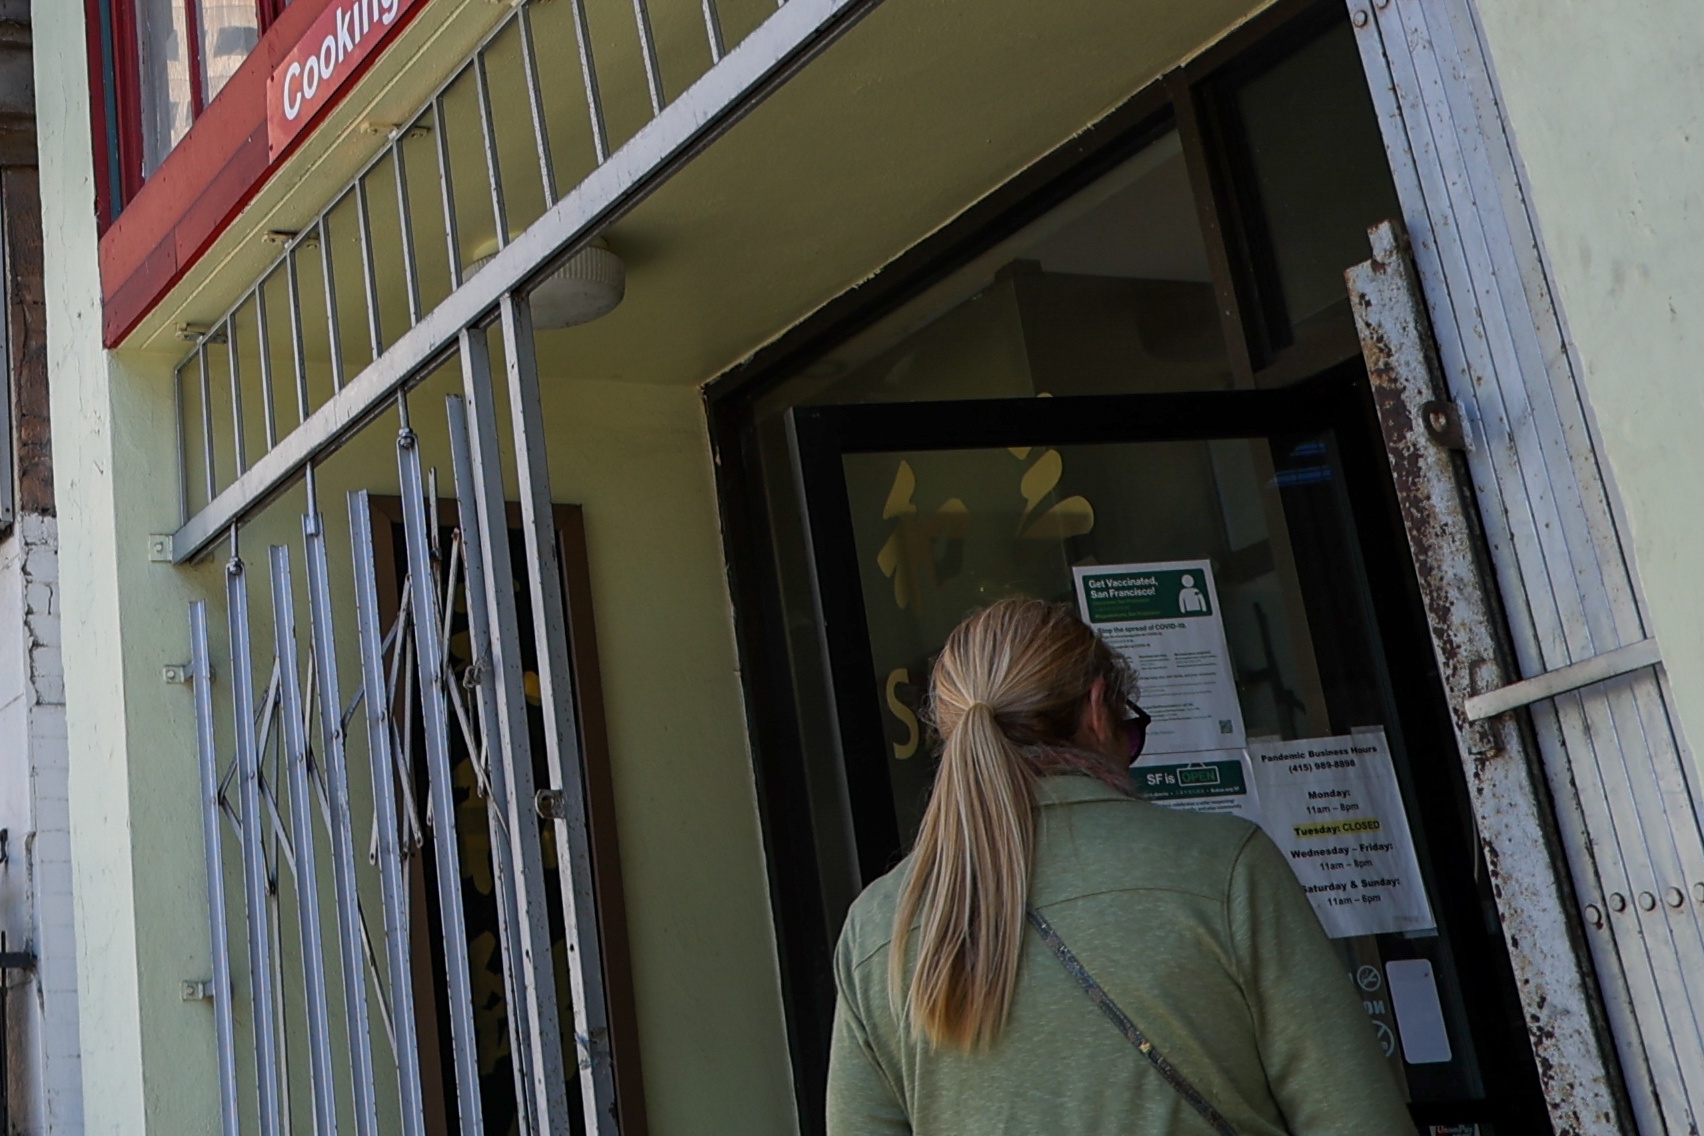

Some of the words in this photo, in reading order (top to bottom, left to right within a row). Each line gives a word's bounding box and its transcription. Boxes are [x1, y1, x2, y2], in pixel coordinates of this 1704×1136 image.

[1089, 578, 1106, 588] Get
[1107, 576, 1159, 588] Vaccinated,
[1091, 589, 1108, 599] San
[1110, 587, 1156, 598] Francisco!
[1125, 624, 1147, 633] spread
[1261, 752, 1305, 763] Pandemic
[1309, 748, 1348, 758] Business
[1351, 745, 1378, 754] Hours
[1289, 763, 1312, 774] (415)
[1146, 773, 1163, 786] SF
[1165, 773, 1176, 784] is
[1181, 770, 1216, 783] OPEN
[1308, 790, 1351, 800] Monday:
[1306, 806, 1331, 815] 11am
[1340, 803, 1359, 813] 8pm
[1294, 825, 1341, 837] Tuesday:
[1342, 821, 1380, 831] CLOSED
[1291, 847, 1349, 859] Wednesday
[1359, 842, 1394, 853] Friday:
[1320, 862, 1344, 871] 11am
[1302, 880, 1346, 893] Saturday
[1350, 879, 1358, 888] &
[1361, 877, 1400, 888] Sunday:
[1327, 897, 1352, 906] 11am
